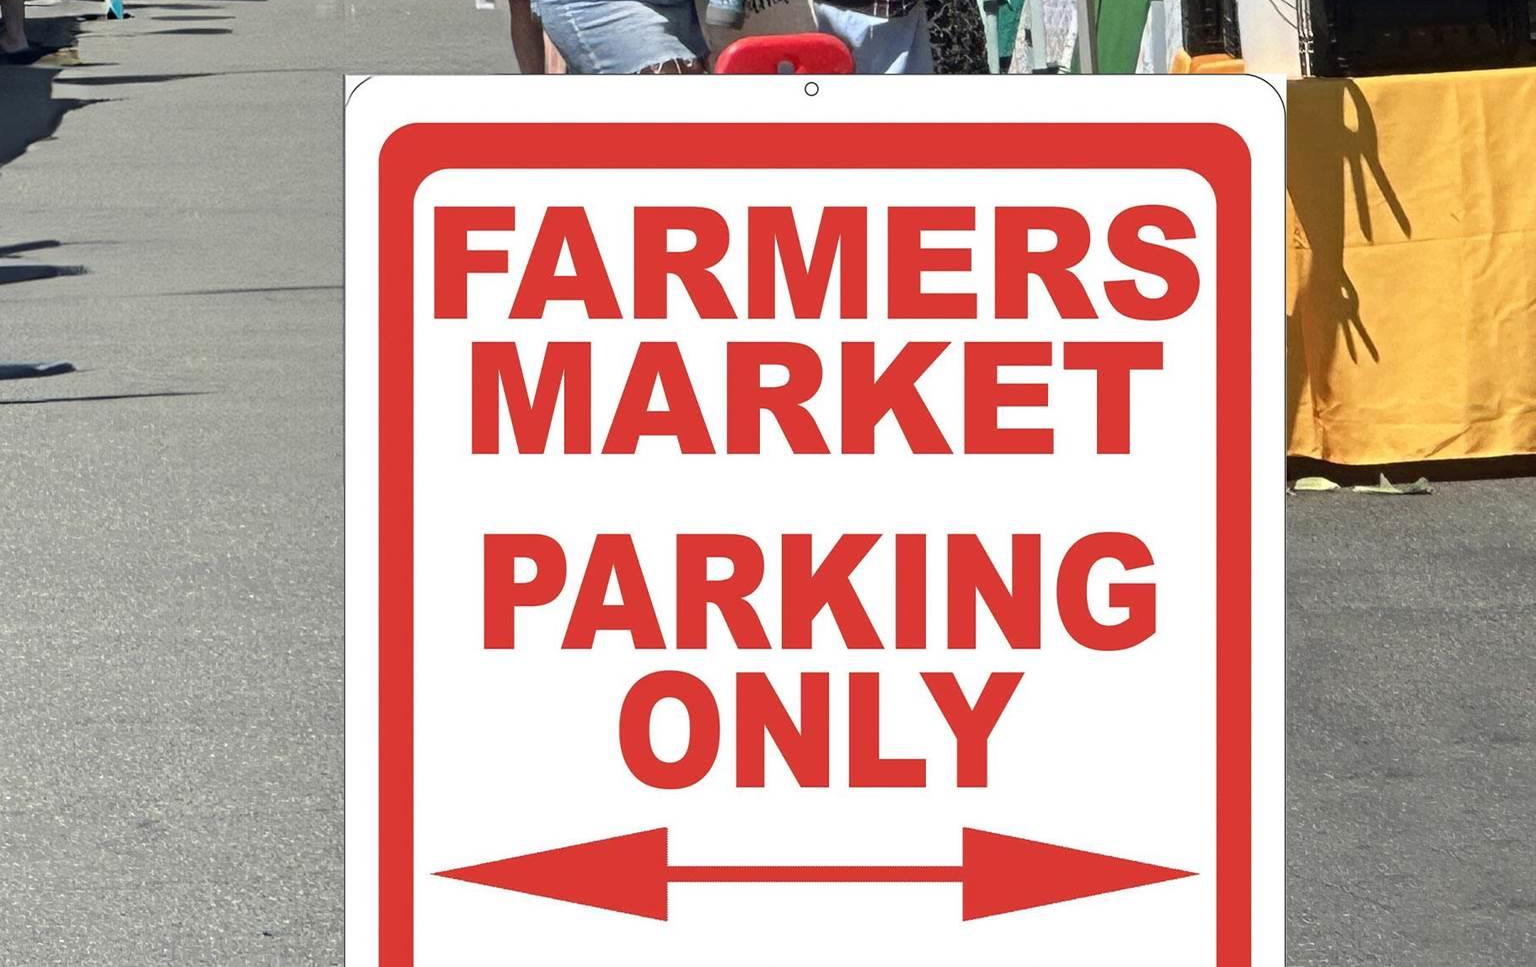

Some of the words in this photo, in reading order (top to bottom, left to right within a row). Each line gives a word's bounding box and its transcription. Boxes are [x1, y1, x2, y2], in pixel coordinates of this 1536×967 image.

[433, 205, 1200, 321] FARMERS
[471, 341, 1164, 455] MARKET
[483, 531, 1156, 650] PARKING
[618, 670, 1024, 790] ONLY
